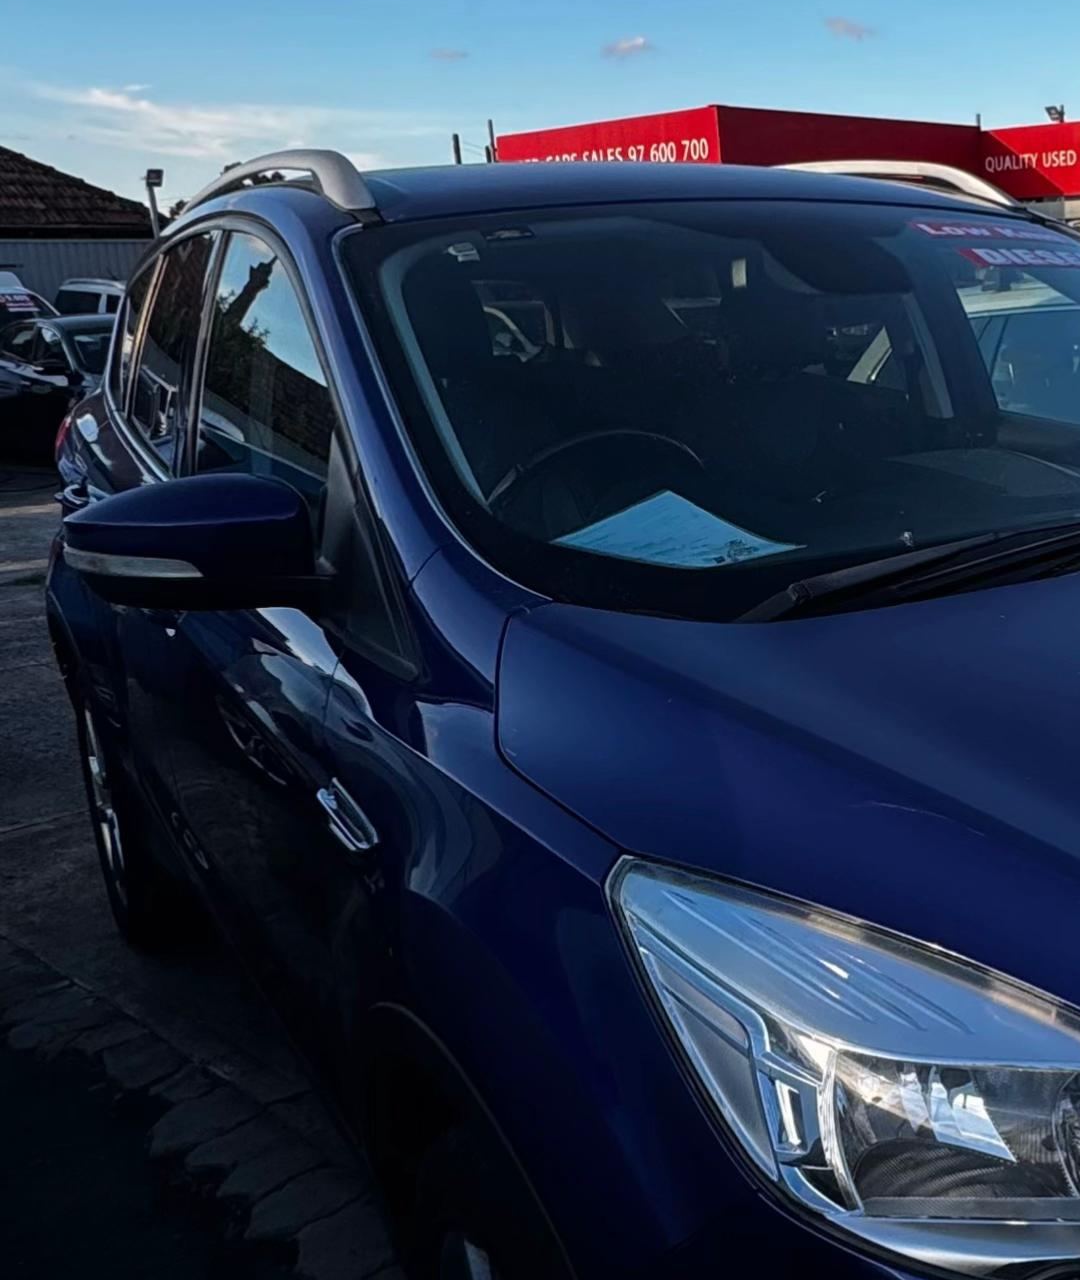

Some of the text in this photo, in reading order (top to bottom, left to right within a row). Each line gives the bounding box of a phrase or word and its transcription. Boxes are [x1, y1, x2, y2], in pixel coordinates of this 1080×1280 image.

[650, 141, 676, 163] 600
[681, 137, 709, 160] 700
[985, 152, 1039, 172] QUALITY
[1042, 149, 1077, 167] USED
